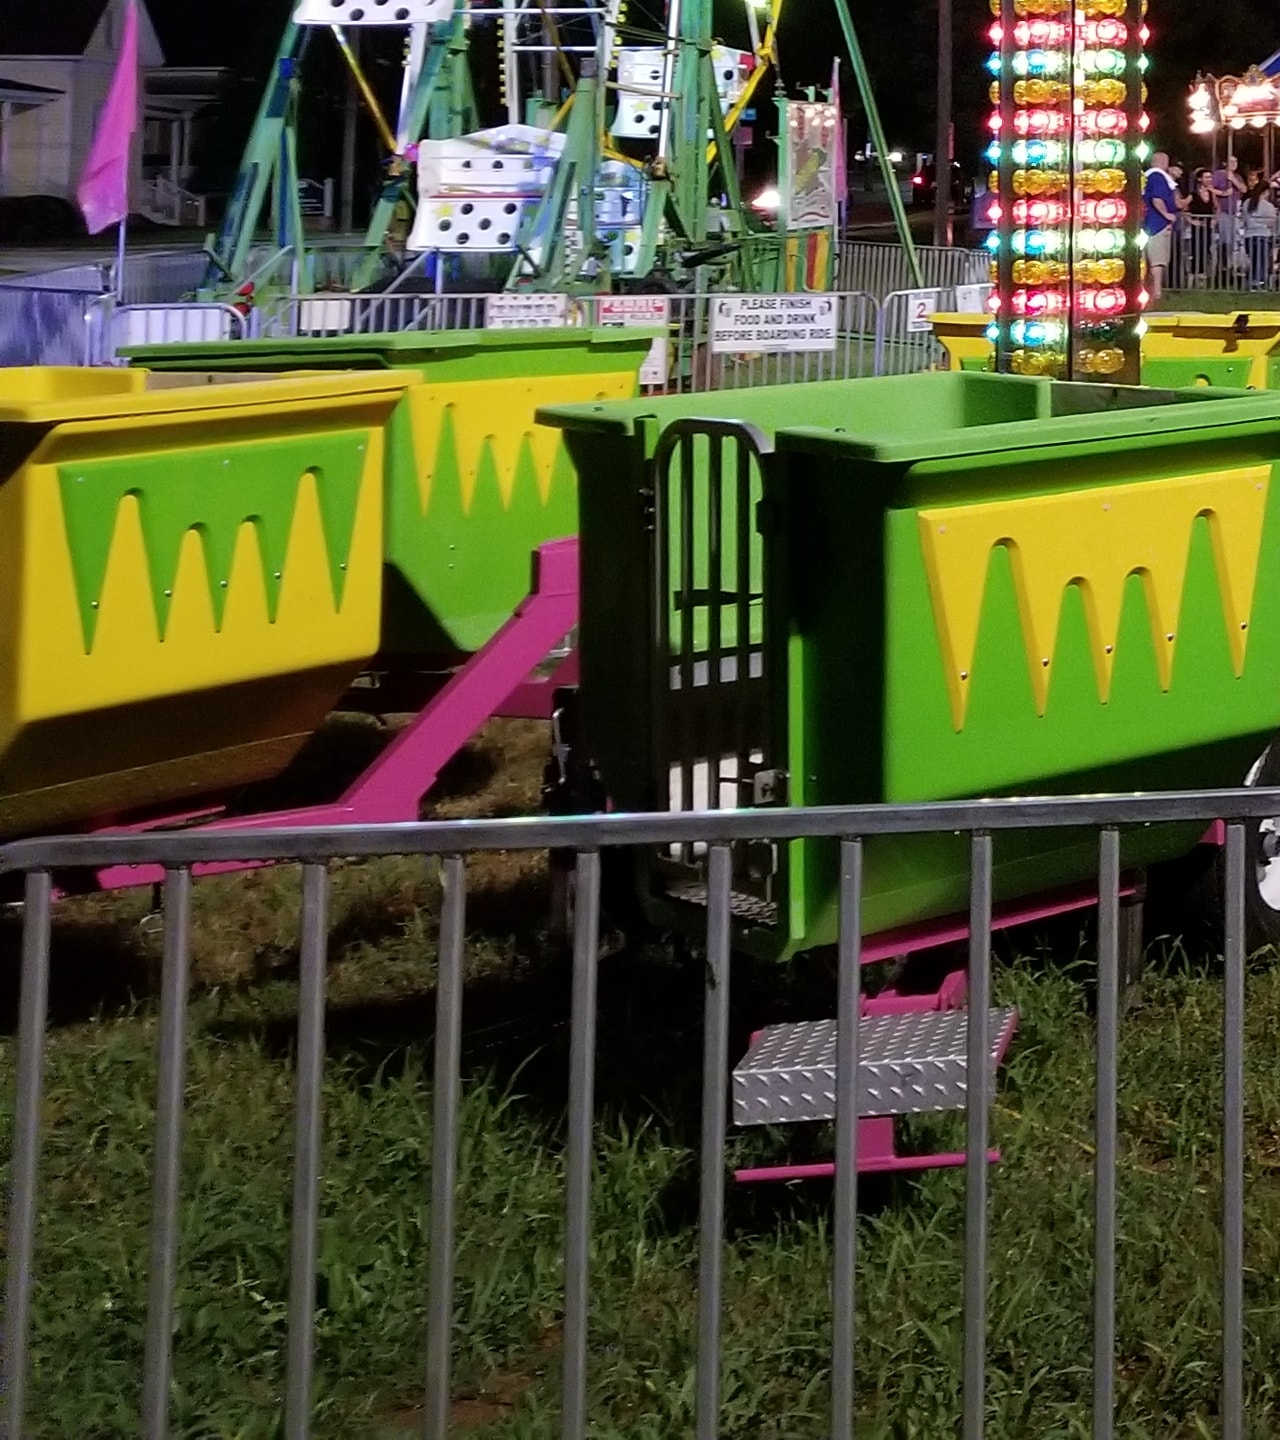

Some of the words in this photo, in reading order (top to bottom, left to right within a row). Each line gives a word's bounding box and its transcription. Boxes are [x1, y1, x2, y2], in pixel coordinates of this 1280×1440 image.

[740, 298, 777, 310] PLEASE
[779, 298, 812, 310] FINISH
[733, 314, 761, 326] FOOD
[763, 313, 784, 325] AND
[786, 312, 817, 325] DRINK
[714, 329, 753, 342] BEFORE
[755, 328, 807, 341] BOARDING
